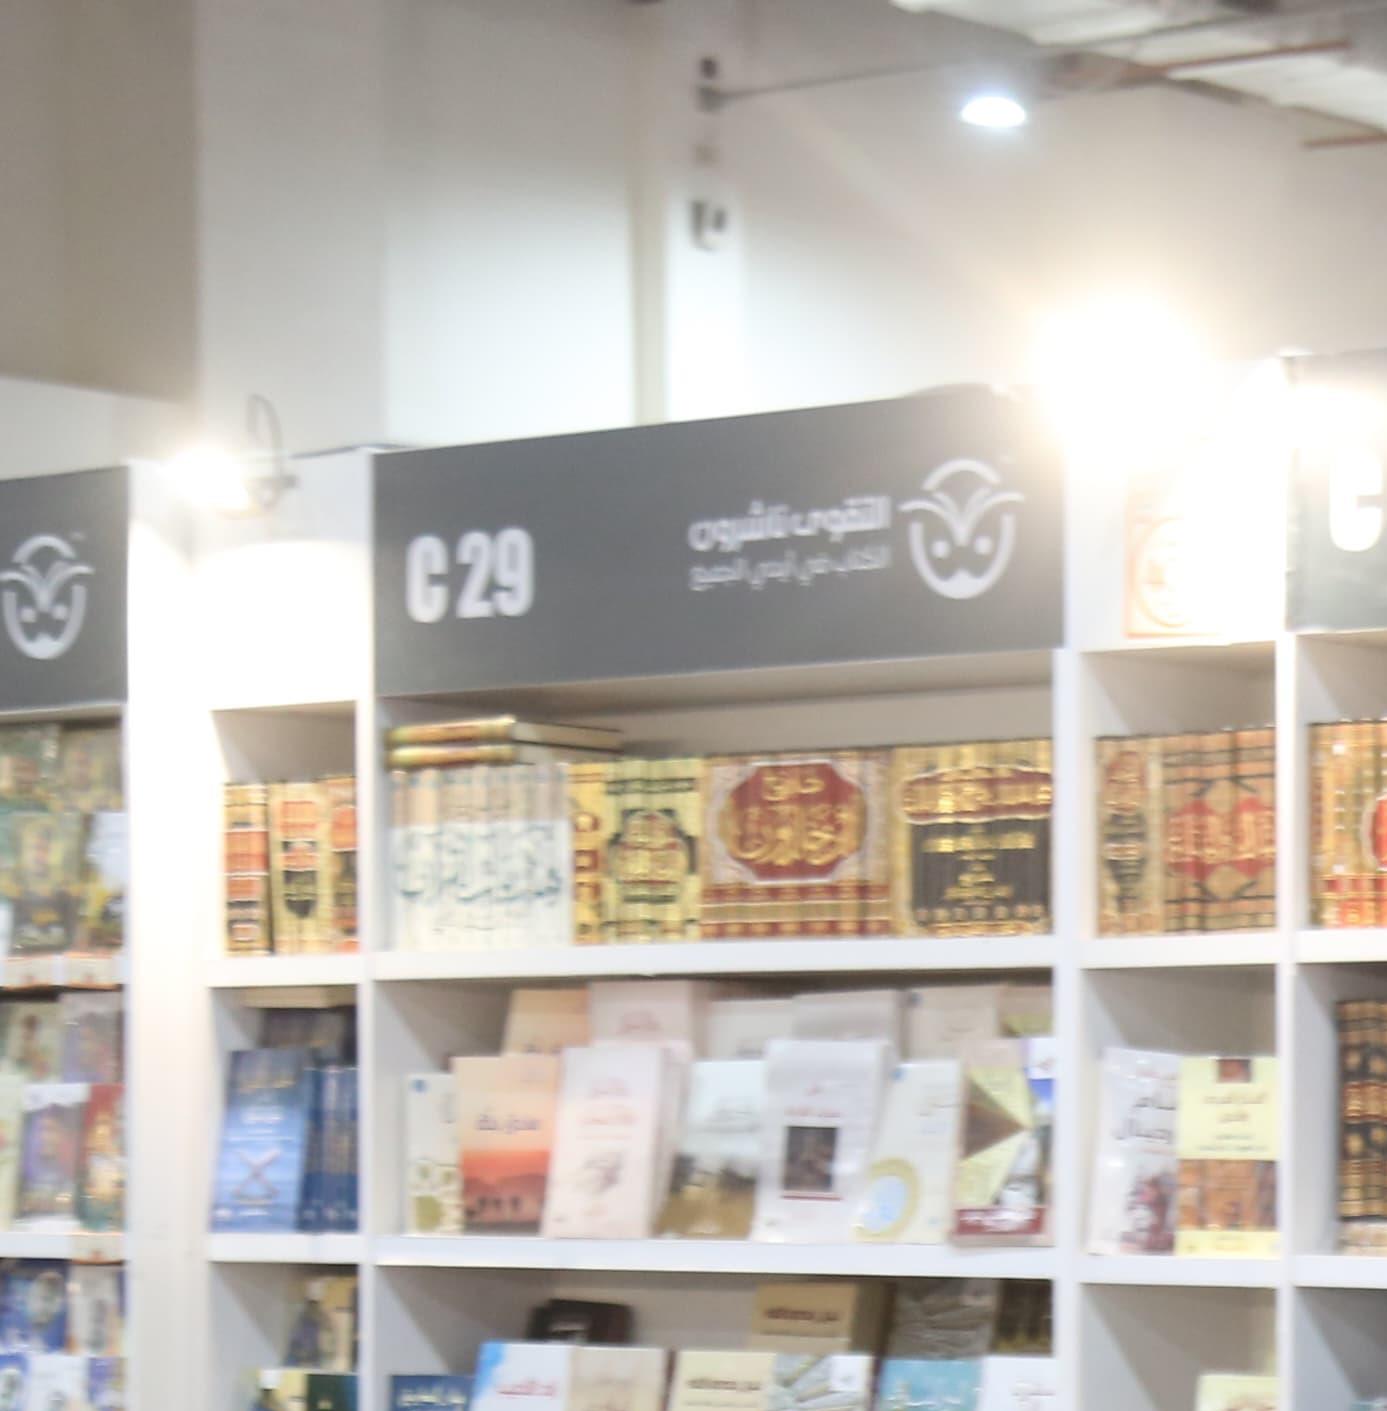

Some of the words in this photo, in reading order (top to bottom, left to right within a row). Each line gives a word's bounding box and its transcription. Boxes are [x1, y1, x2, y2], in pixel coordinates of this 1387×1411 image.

[688, 499, 790, 551] ناشرون
[790, 496, 891, 543] التقوى
[407, 536, 448, 623] C
[457, 527, 535, 618] 29
